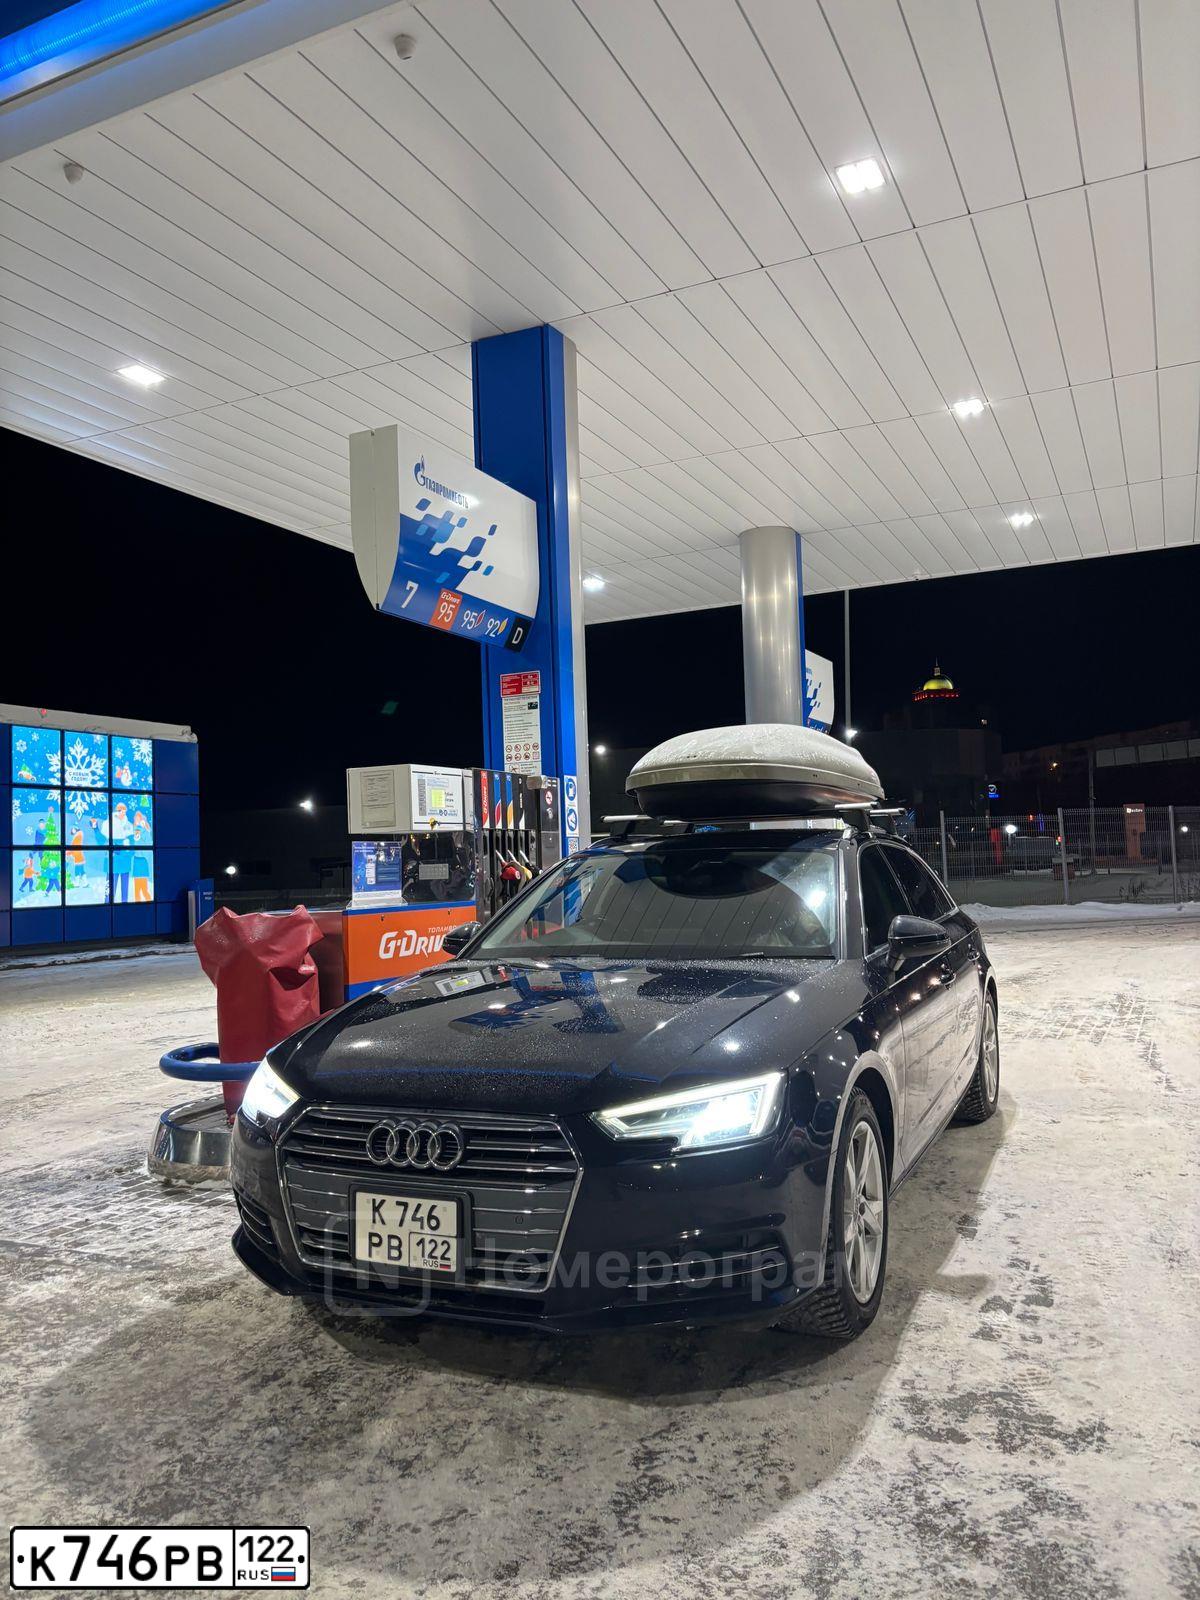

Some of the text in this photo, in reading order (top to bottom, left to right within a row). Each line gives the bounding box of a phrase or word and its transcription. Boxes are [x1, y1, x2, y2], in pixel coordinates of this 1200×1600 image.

[401, 580, 419, 609] 7
[438, 602, 455, 623] 95
[461, 610, 524, 644] 95 92 D
[379, 929, 446, 960] G-DRIV
[368, 1232, 451, 1262] РВ 122
[422, 1258, 439, 1268] RUS
